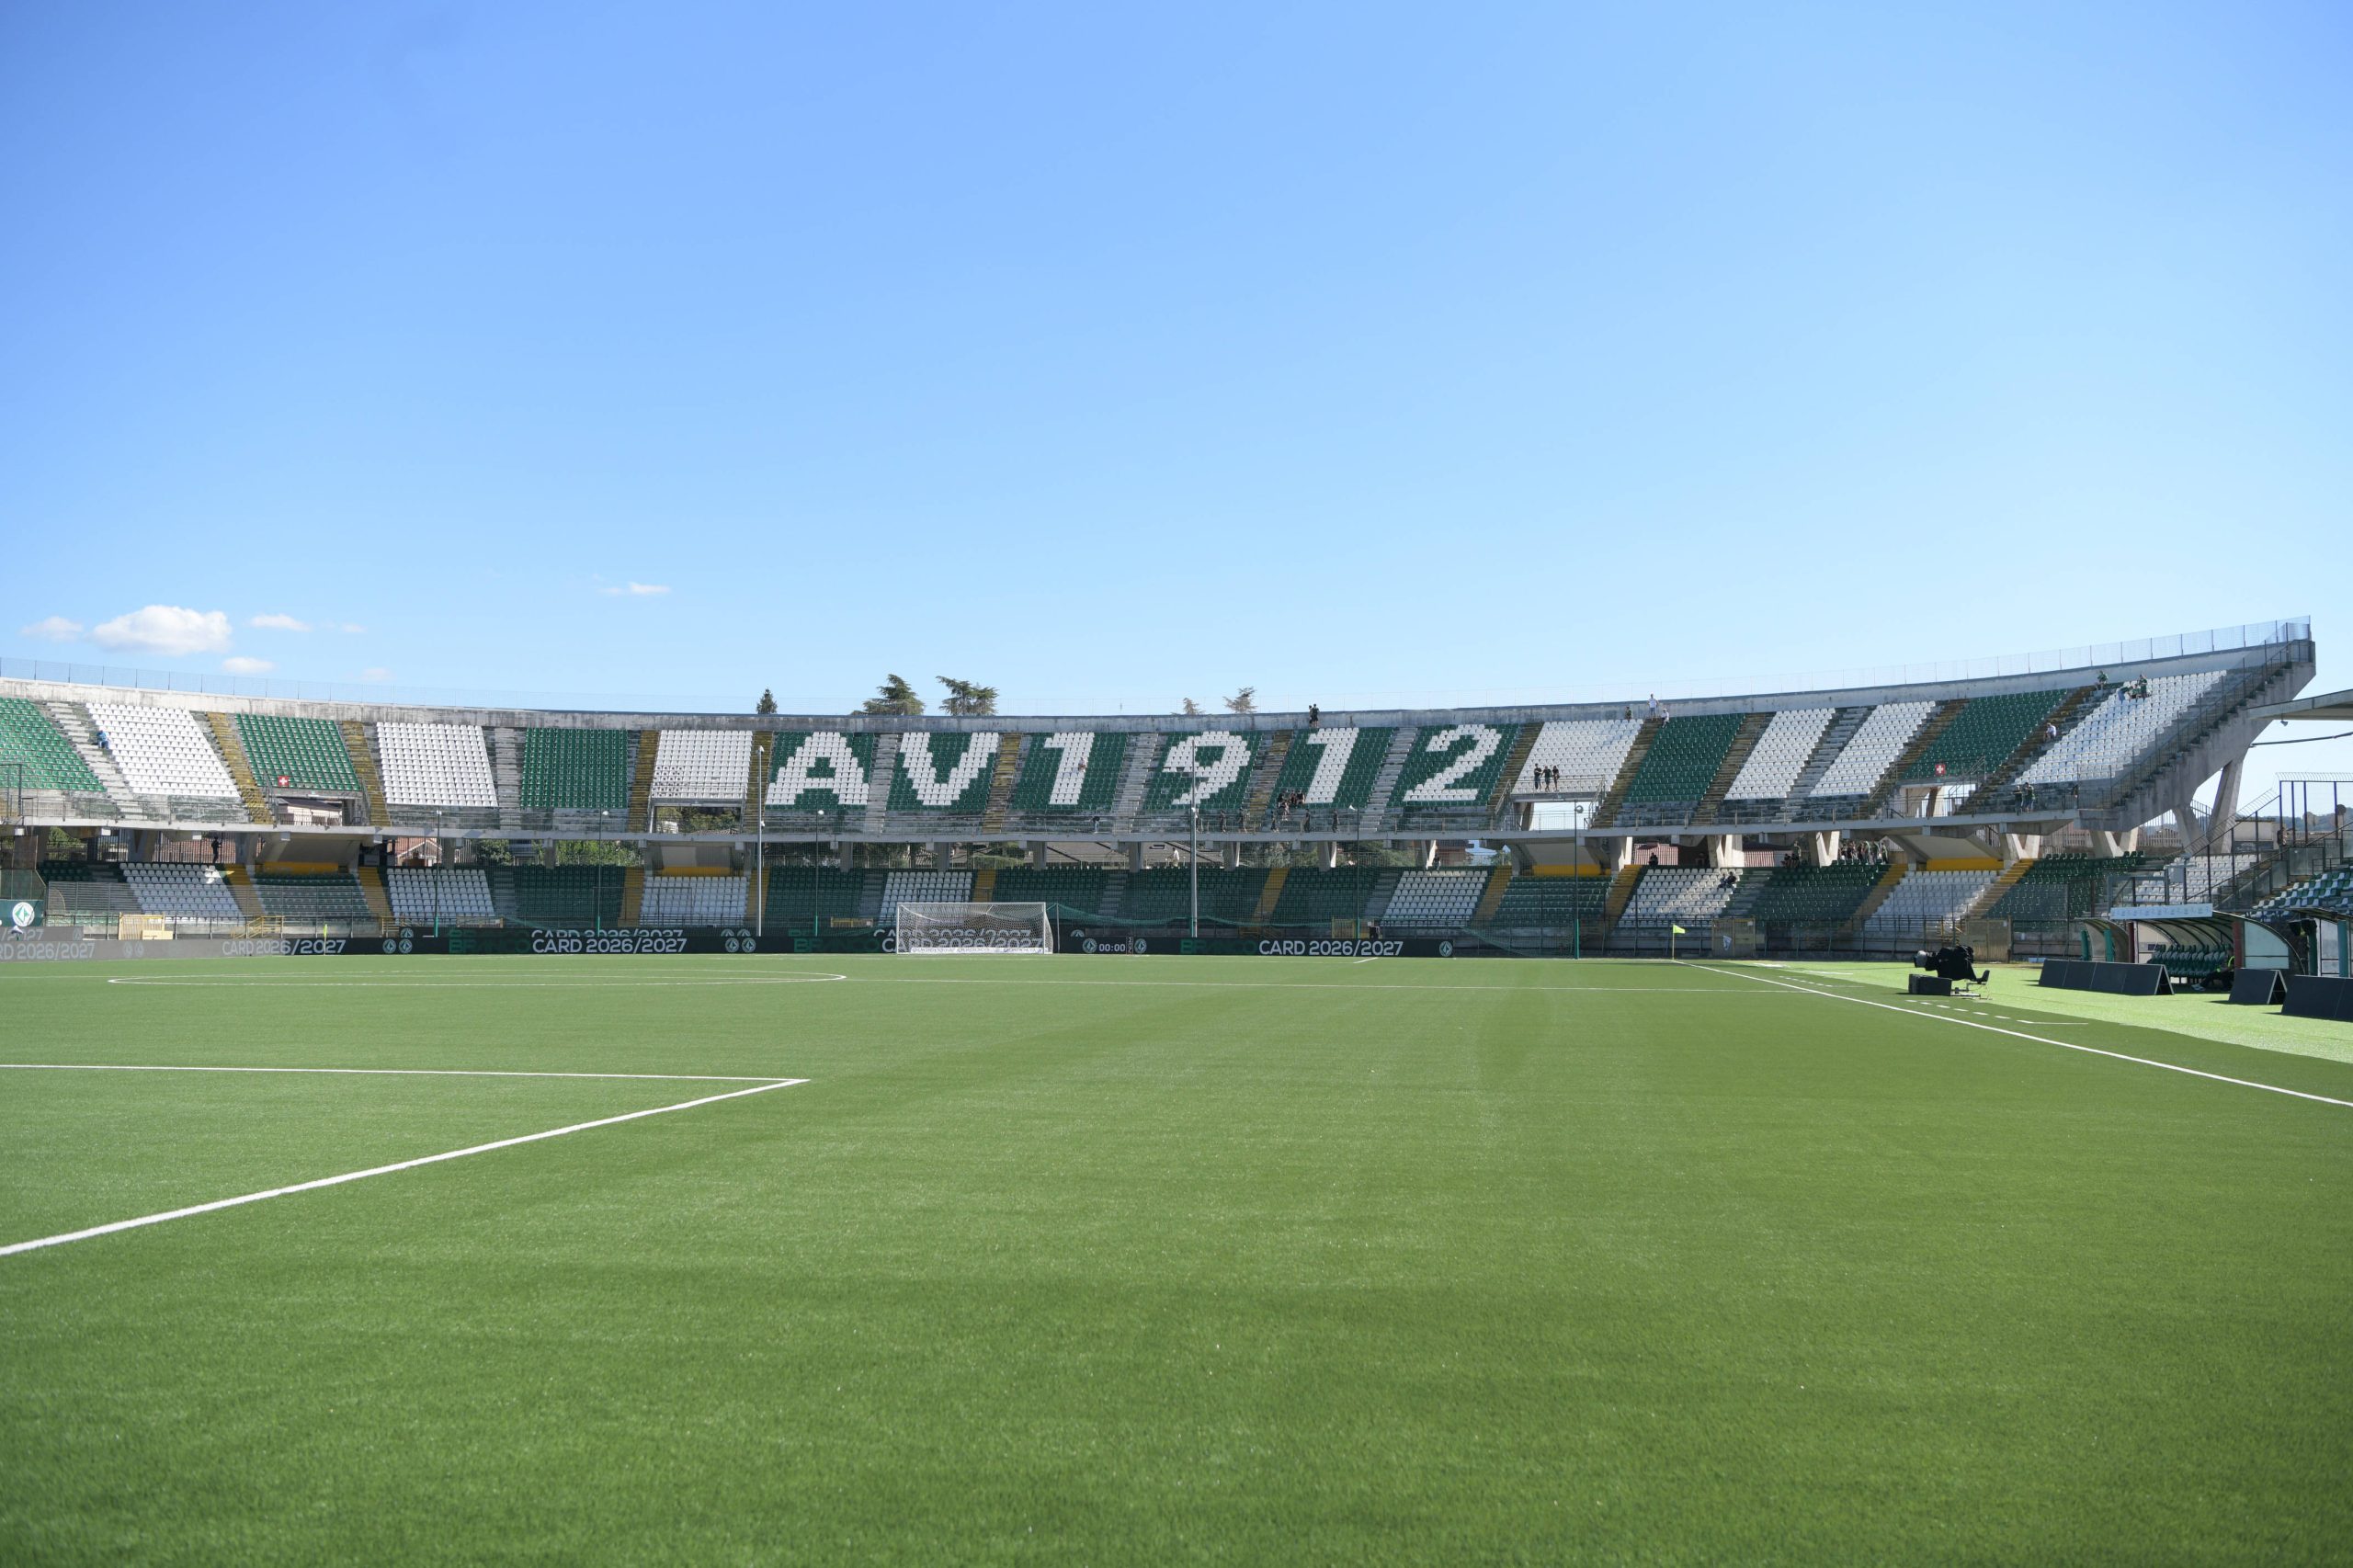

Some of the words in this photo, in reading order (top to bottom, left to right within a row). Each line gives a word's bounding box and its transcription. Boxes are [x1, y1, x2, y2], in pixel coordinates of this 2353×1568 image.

[17, 942, 95, 960] 2026/2027
[222, 939, 255, 955] CARD
[256, 939, 347, 955] 2026/2027
[532, 938, 583, 953] CARD
[585, 937, 688, 953] 2026/2027
[1098, 943, 1126, 952] 00:00
[1258, 939, 1306, 955] CARD
[1309, 939, 1404, 956] 2026/2027
